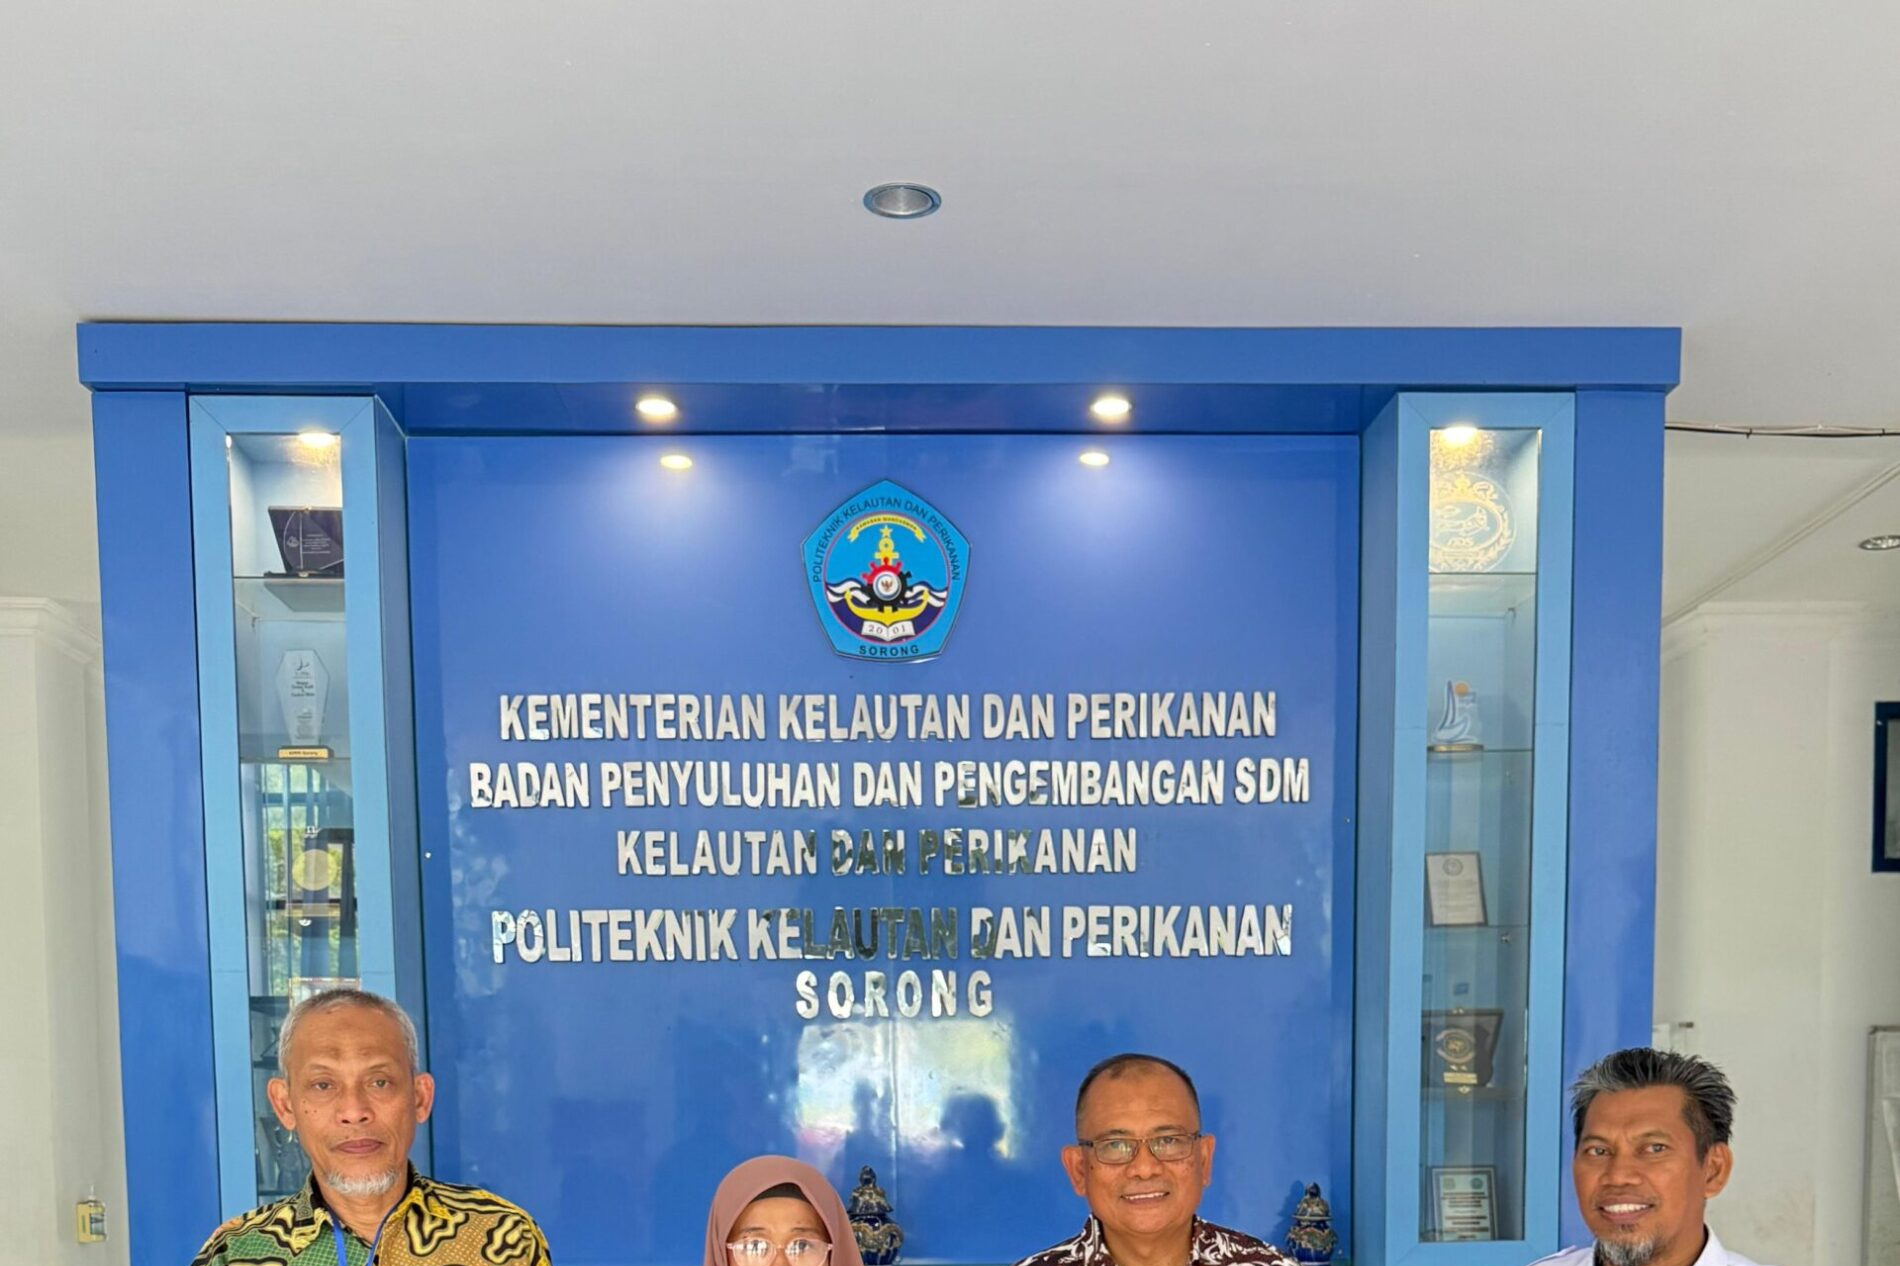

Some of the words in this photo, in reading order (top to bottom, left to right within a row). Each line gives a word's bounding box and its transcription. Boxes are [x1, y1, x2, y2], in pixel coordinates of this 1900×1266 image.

[812, 515, 844, 583] POLITEKNIK
[843, 497, 902, 520] KELAUTAN
[904, 501, 930, 518] DAN
[928, 514, 961, 581] PERIKANAN
[859, 644, 919, 657] SORONG
[500, 693, 766, 741] KEMENTERIAN
[778, 693, 970, 742] KELAUTAN
[983, 693, 1055, 740] DAN
[1067, 691, 1276, 740] PERIKANAN
[469, 762, 590, 808] BADAN
[600, 761, 840, 808] PENYULUHAN
[853, 761, 922, 808] DAN
[934, 759, 1225, 808] PENGEMBANGAN
[1234, 757, 1310, 804] SDM
[617, 829, 817, 876] KELAUTAN
[831, 829, 905, 876] DAN
[918, 827, 1137, 875] PERIKANAN
[491, 908, 739, 963] POLITEKNIK
[748, 906, 958, 961] KELAUTAN
[970, 906, 1051, 960] DAN
[1062, 903, 1293, 958] PERIKANAN
[795, 970, 993, 1019] SORONG
